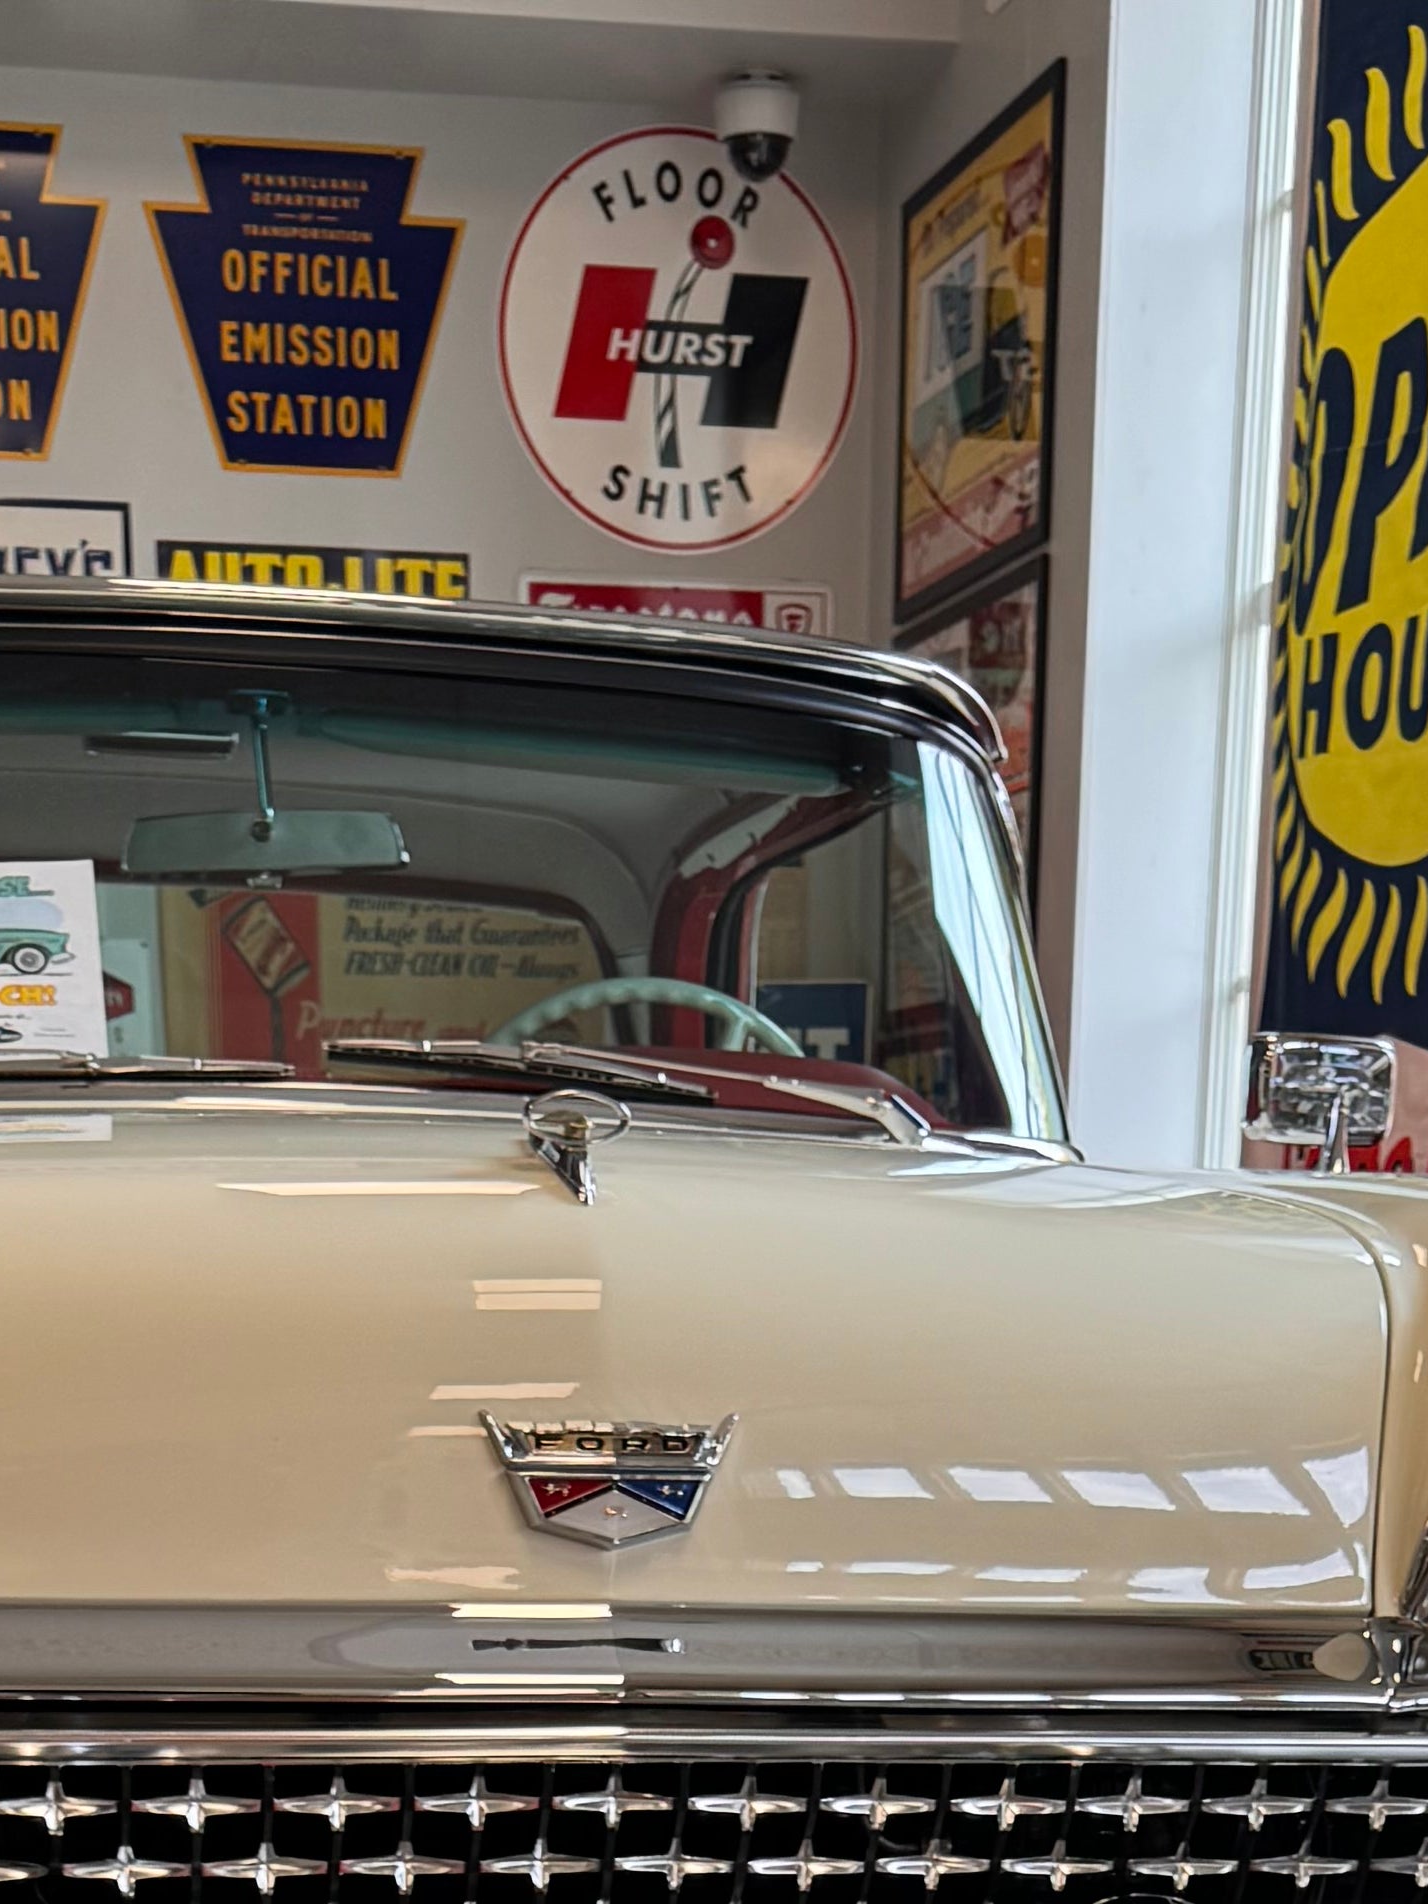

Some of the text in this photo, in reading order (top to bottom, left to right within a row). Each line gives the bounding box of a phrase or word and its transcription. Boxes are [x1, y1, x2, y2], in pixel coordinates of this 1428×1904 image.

[591, 161, 763, 230] FLOOR
[221, 249, 399, 301] OFFICIAL
[220, 320, 399, 370] EMISSION
[606, 326, 753, 368] HURST
[226, 390, 388, 439] STATION
[601, 463, 754, 521] SHIFT
[425, 919, 465, 945] that
[534, 1434, 691, 1454] FORD
